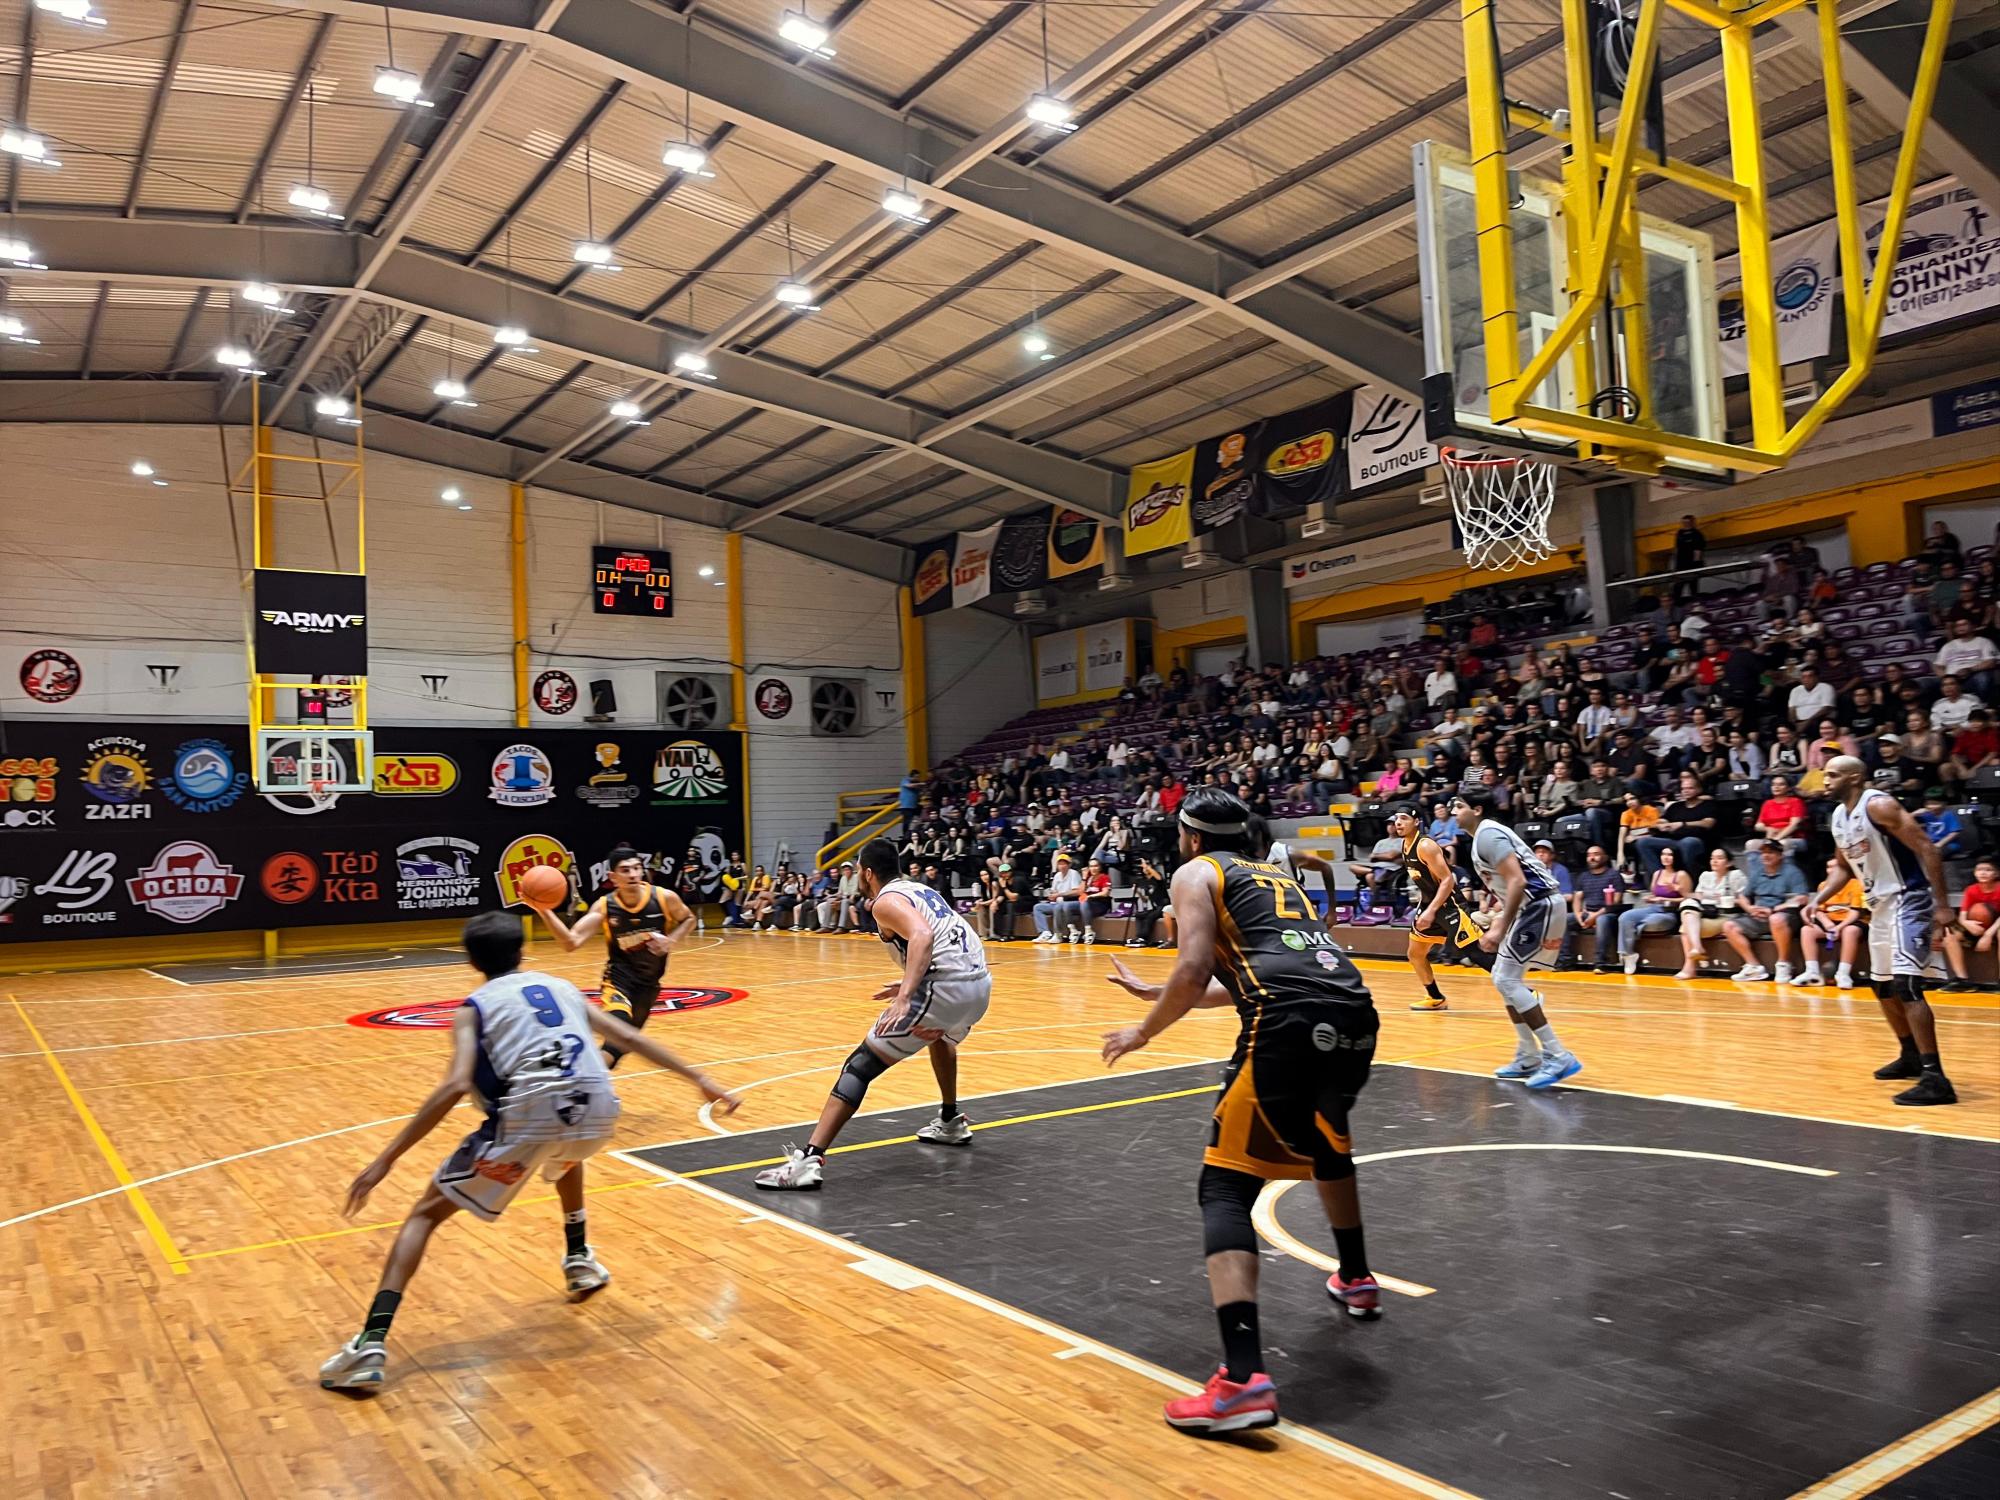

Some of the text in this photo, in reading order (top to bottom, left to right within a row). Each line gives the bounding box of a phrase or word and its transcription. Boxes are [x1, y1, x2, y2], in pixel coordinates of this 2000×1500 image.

[1361, 447, 1428, 480] BOUTIQUE
[1309, 554, 1357, 573] Chevron
[645, 573, 670, 588] 00
[265, 610, 356, 628] ARMY
[87, 736, 147, 752] ACUICOLA
[506, 745, 538, 755] TACOS
[158, 771, 250, 813] SAN ANTONIO
[85, 804, 151, 820] ZAZFI
[143, 877, 227, 897] OCHOA
[323, 877, 379, 903] Kta
[396, 877, 480, 888] HERNANDEZ
[42, 911, 117, 924] BOUTIQUE
[521, 984, 565, 1028] 9
